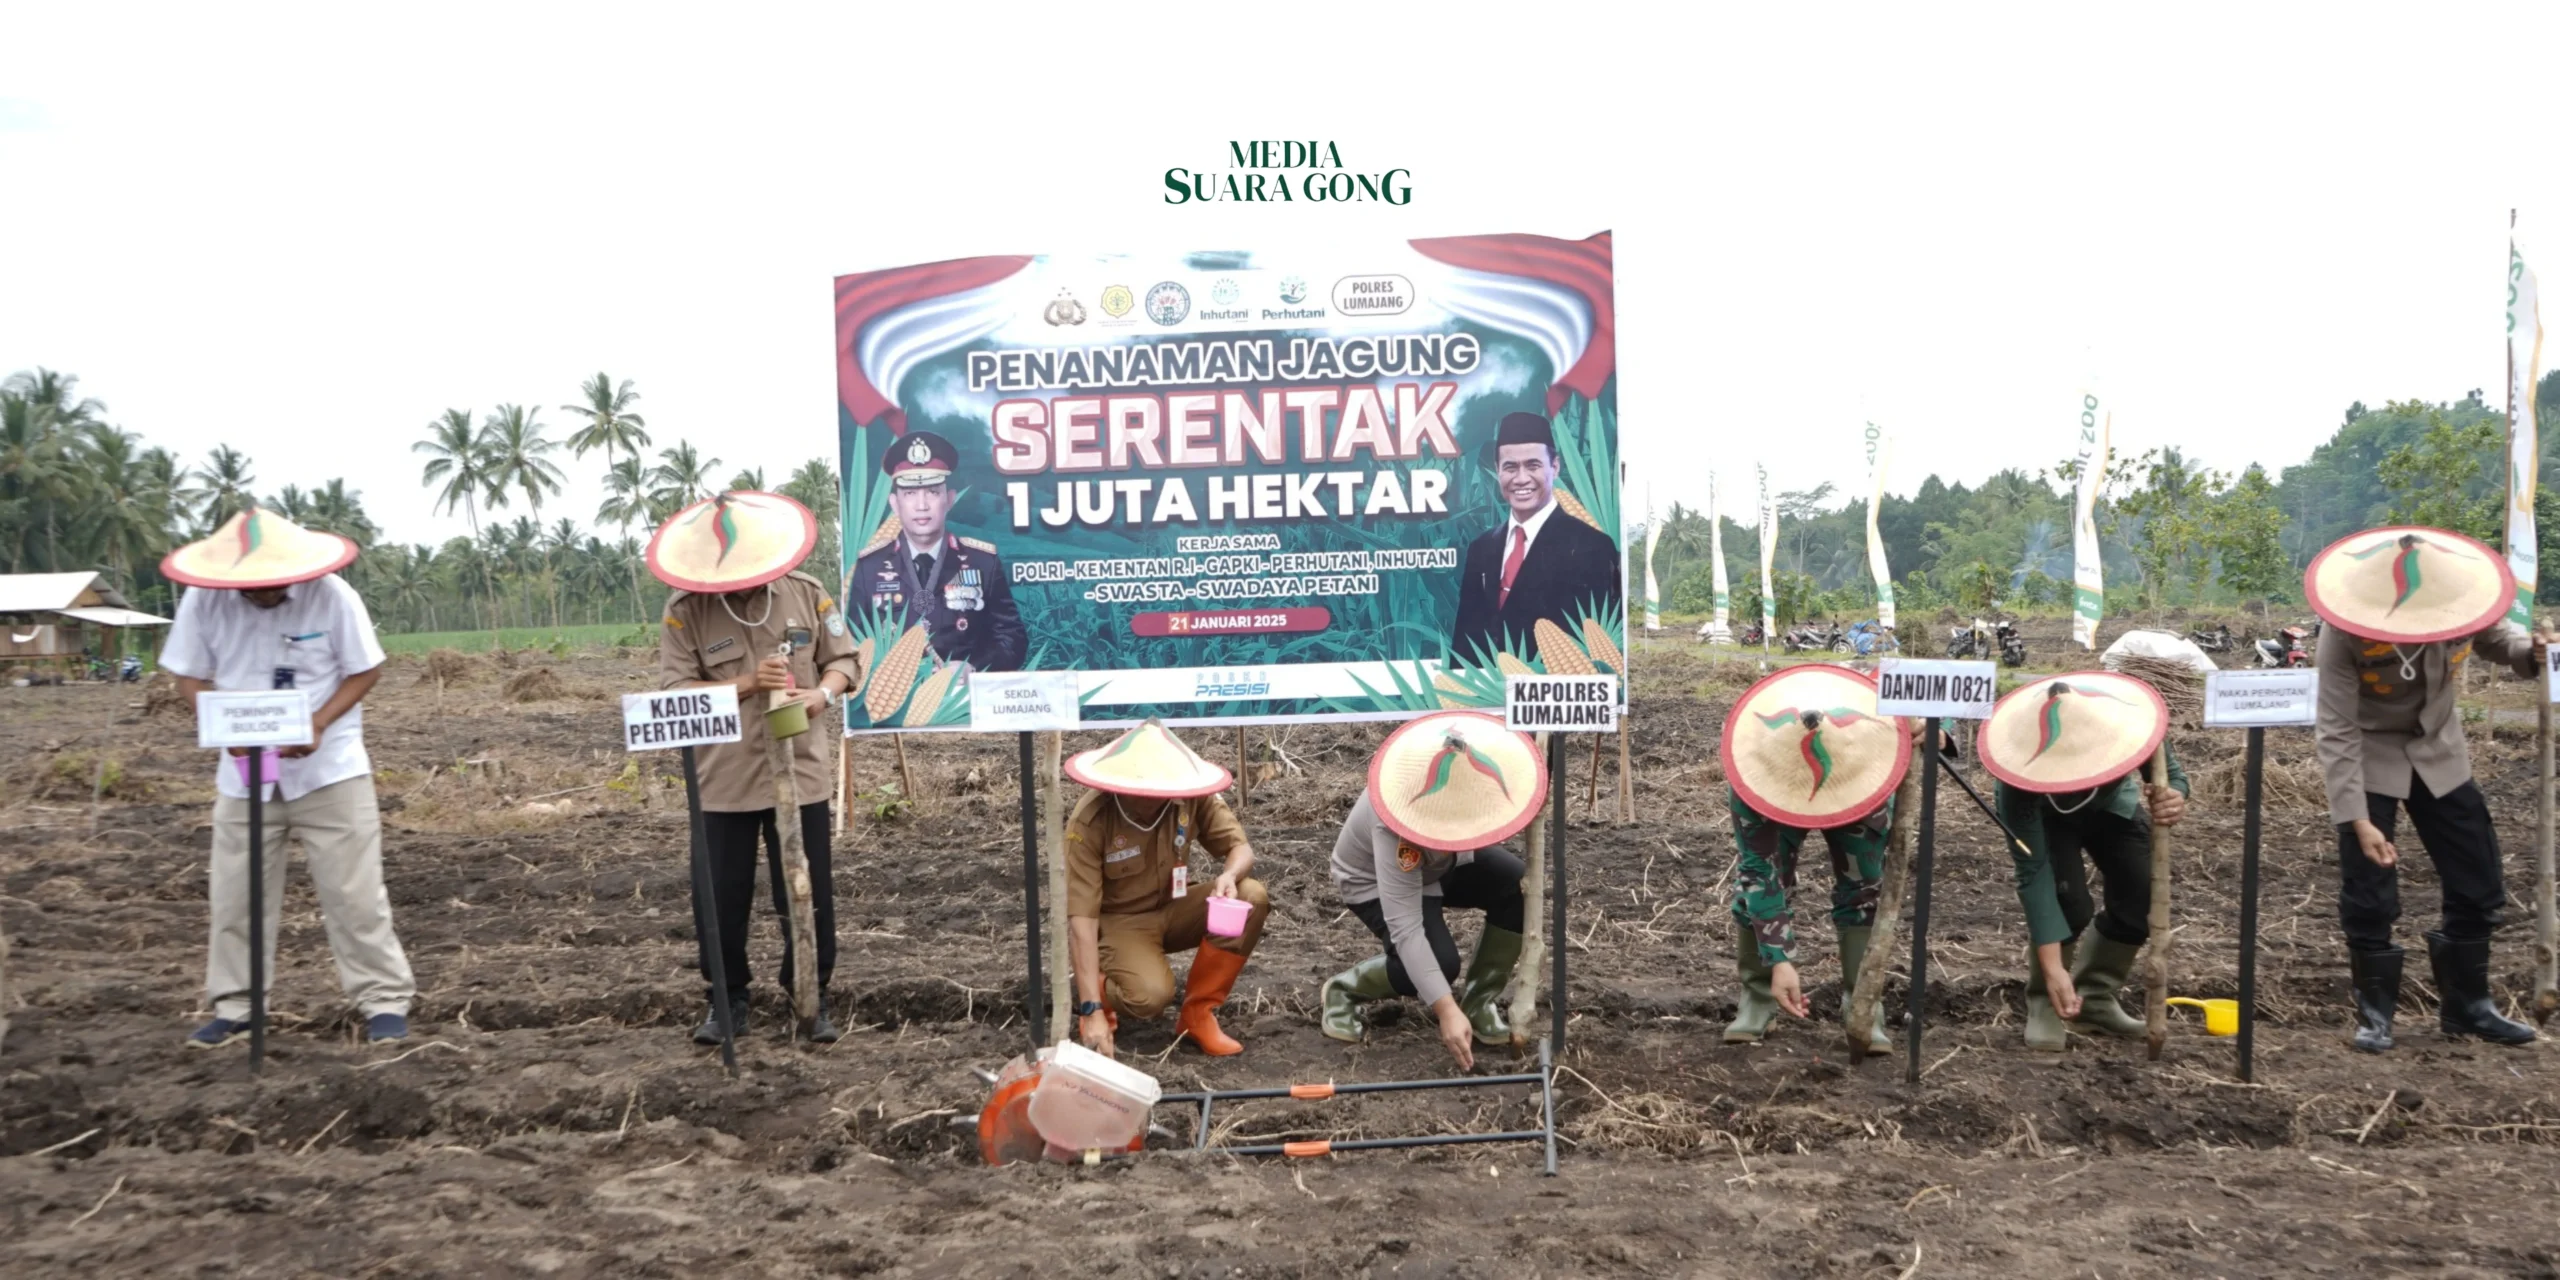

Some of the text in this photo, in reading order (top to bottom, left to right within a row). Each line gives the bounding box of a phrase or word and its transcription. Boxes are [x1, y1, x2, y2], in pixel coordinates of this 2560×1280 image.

[1352, 281, 1394, 294] POLRES
[1343, 296, 1403, 310] LUMAJANG
[1200, 308, 1249, 321] Inhutani
[1262, 307, 1325, 320] Perhutani
[970, 335, 1477, 388] PENANAMAN JAGUNG
[994, 384, 1460, 472] SERENTAK
[1007, 470, 1448, 526] 1 JUTA HEKTAR
[1178, 534, 1280, 551] KERJA SAMA
[1014, 562, 1064, 581] POLRI
[1075, 558, 1170, 579] KEMENTAN
[1174, 558, 1195, 576] R.I
[1206, 556, 1260, 575] GAPKI
[1271, 553, 1374, 572] PERHUTANI,
[1375, 550, 1456, 568] INHUTANI
[1095, 583, 1184, 602] SWASTA
[1197, 579, 1301, 599] SWADAYA
[1304, 575, 1378, 594] PETANI
[1170, 614, 1287, 630] 21 JANUARI 2025
[1004, 689, 1038, 699] SEKDA
[1195, 683, 1270, 696] PRESISI
[1514, 682, 1609, 702] KAPOLRES
[1881, 673, 1991, 702] DANDIM 0821
[2218, 687, 2308, 698] WAKA PERHUTANI
[650, 694, 712, 719] KADIS
[993, 704, 1051, 715] LUMAJANG
[2234, 700, 2291, 710] LUMAJANG
[1512, 705, 1610, 725] LUMAJANG
[231, 721, 280, 733] BULOG
[629, 714, 738, 744] PERTANIAN
